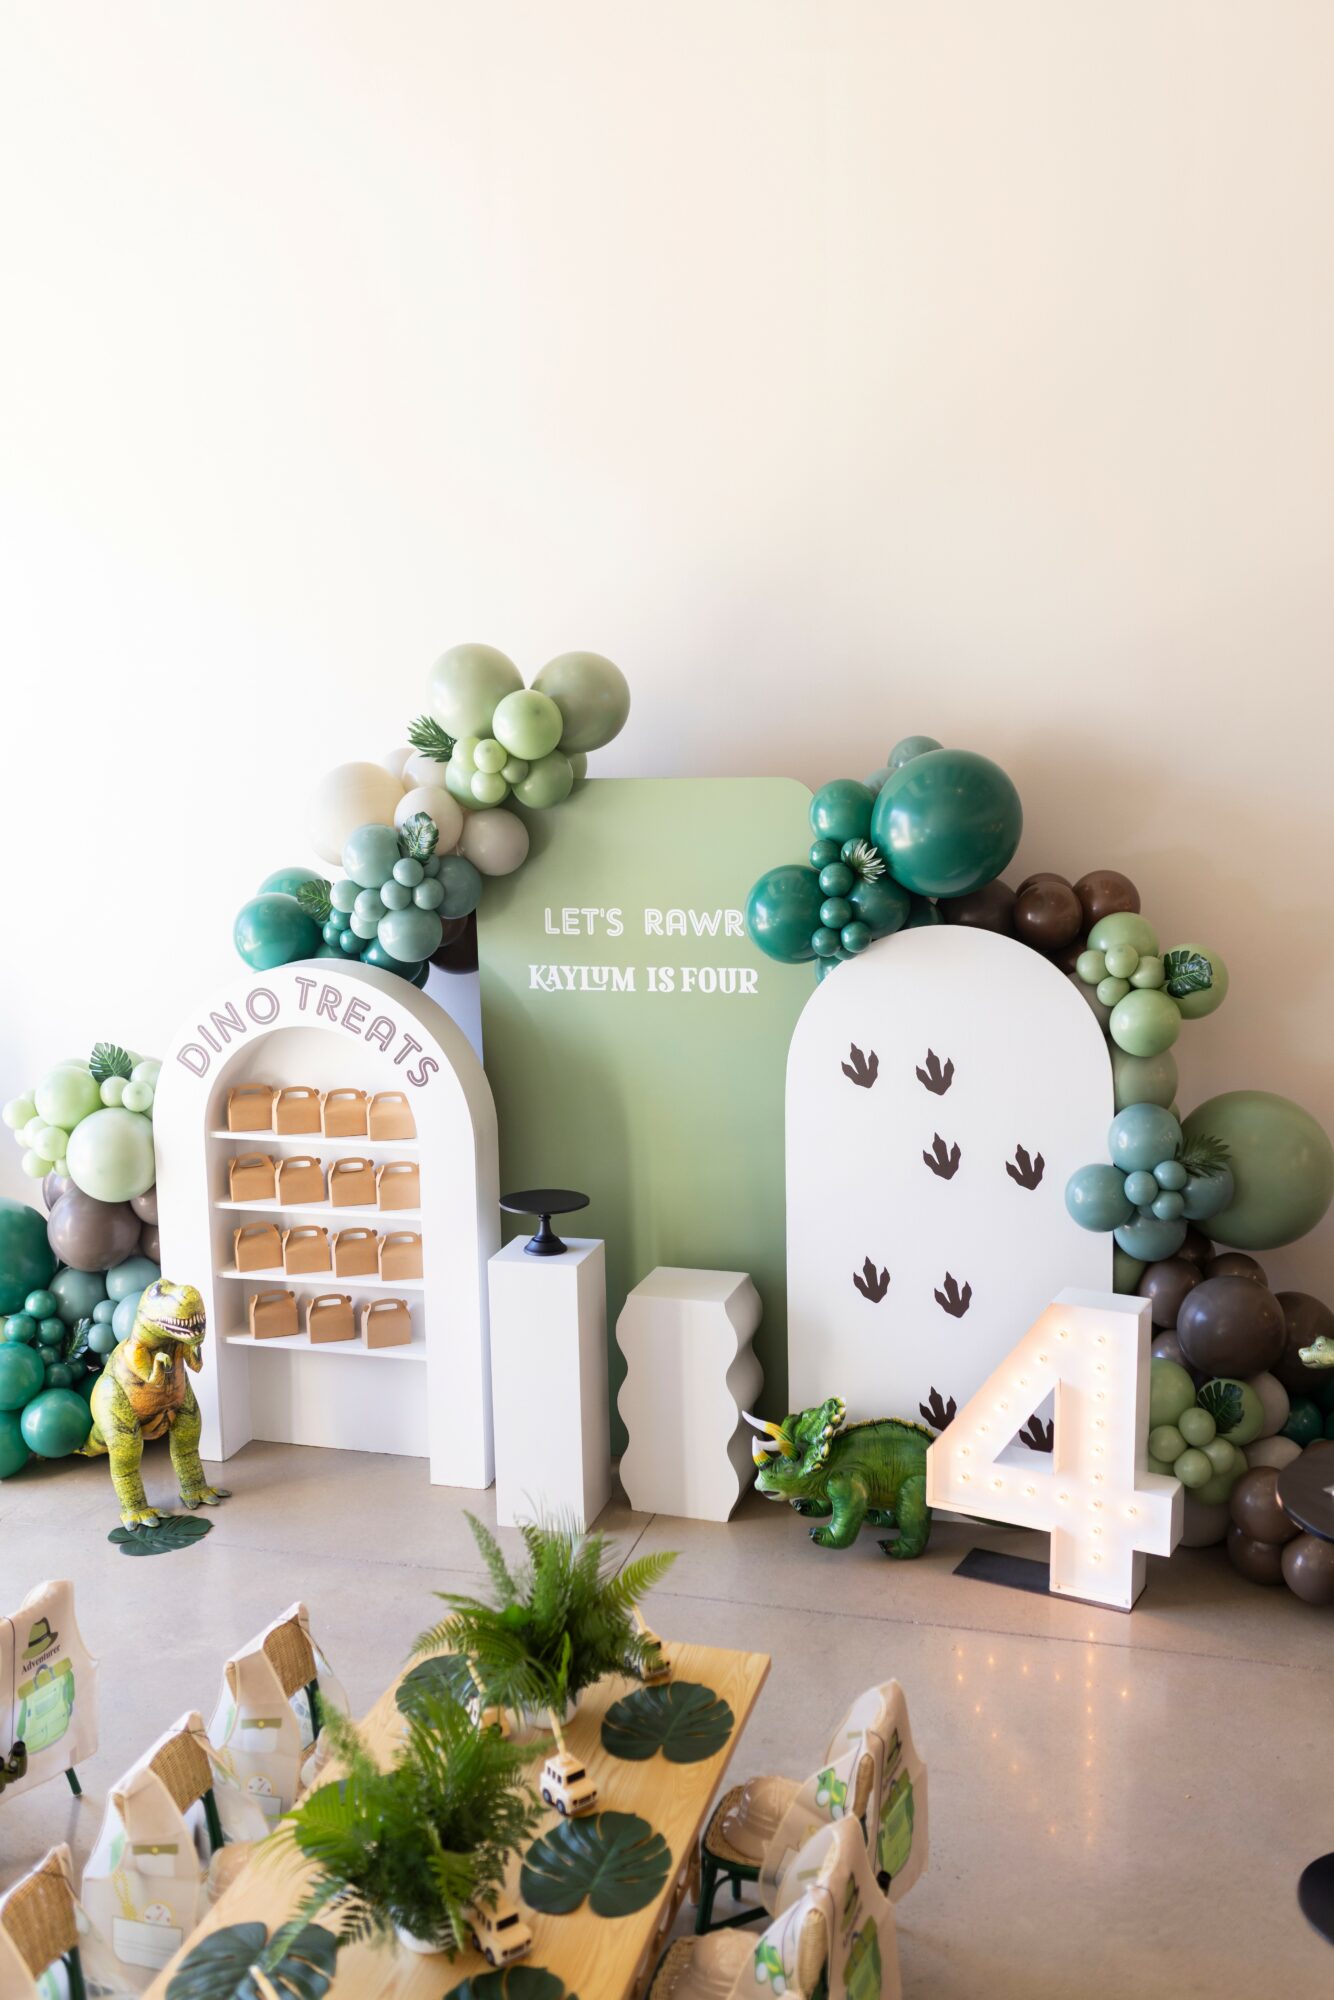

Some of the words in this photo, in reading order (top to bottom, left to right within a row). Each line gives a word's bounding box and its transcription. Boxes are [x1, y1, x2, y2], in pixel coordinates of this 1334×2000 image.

[544, 907, 624, 937] LET'S
[644, 908, 745, 937] RAWR
[528, 964, 637, 993] KAYLUM
[647, 966, 675, 993] IS
[681, 967, 759, 994] FOUR
[176, 987, 281, 1078] DINO
[294, 976, 440, 1088] TREATS
[926, 1288, 1184, 1610] 4
[21, 1644, 61, 1674] Adventurer
